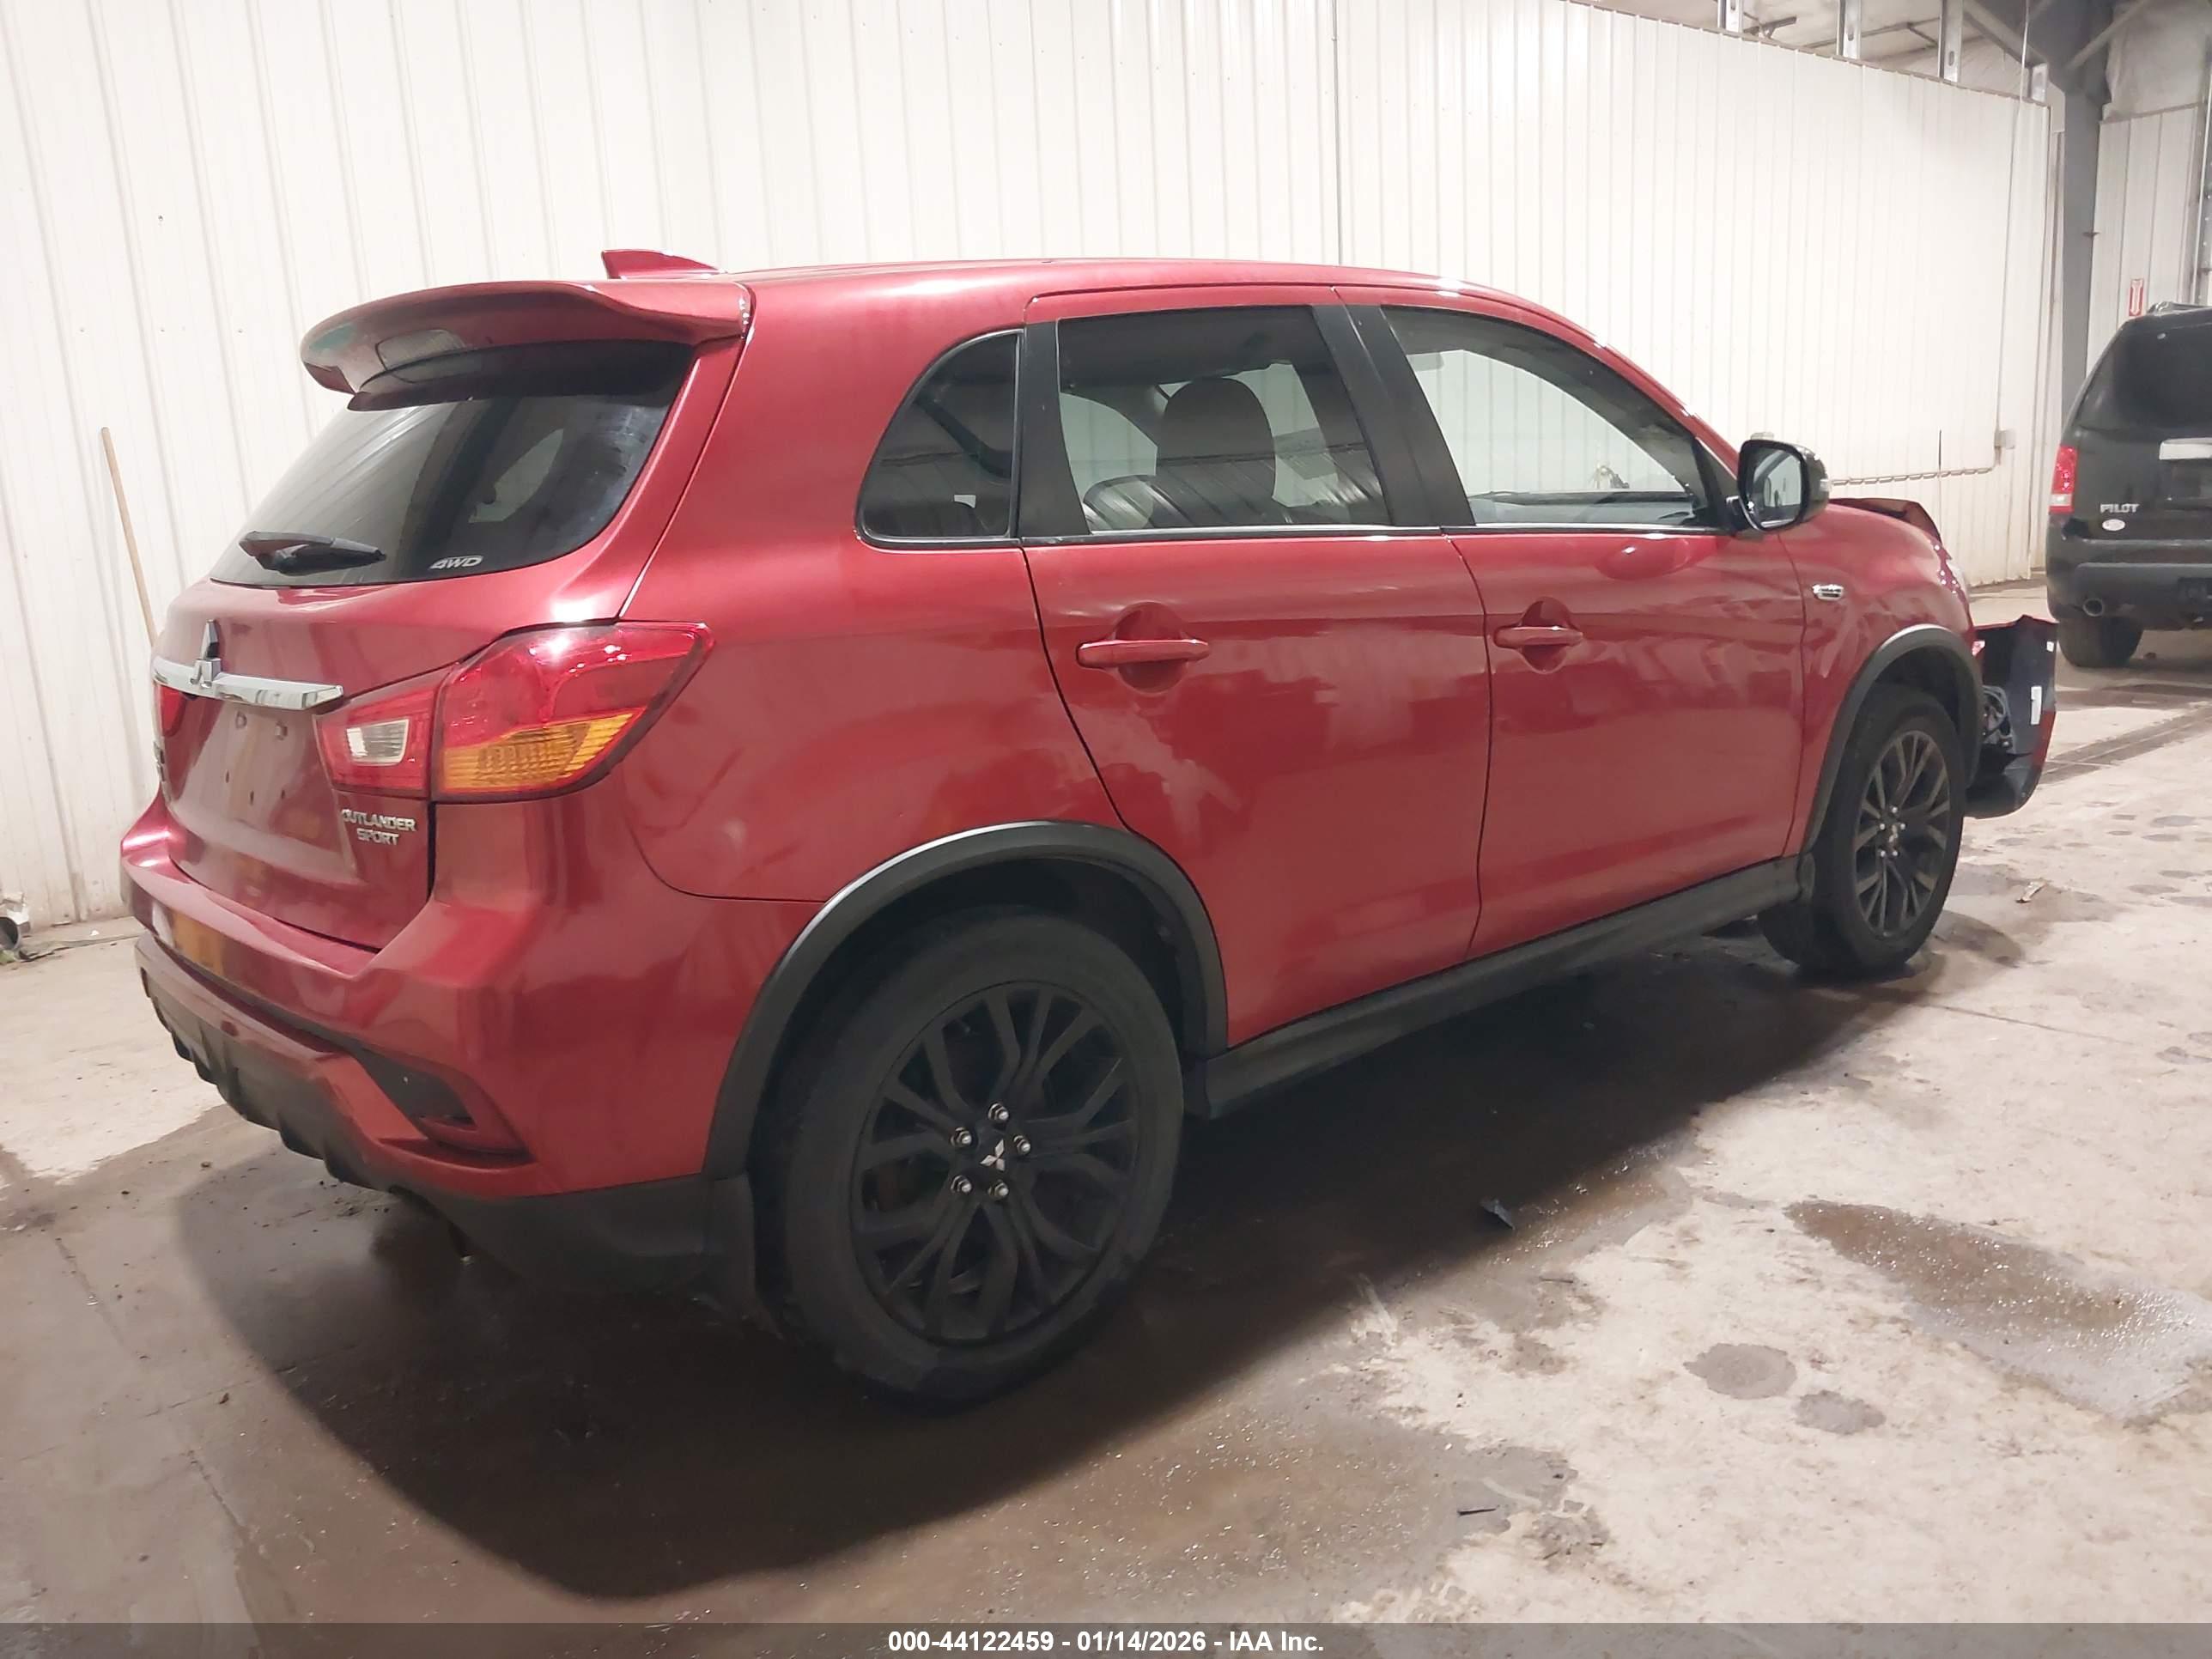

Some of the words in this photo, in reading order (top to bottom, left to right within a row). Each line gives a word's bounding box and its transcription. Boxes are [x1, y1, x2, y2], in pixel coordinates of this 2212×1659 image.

[2100, 503, 2140, 514] PILOT
[429, 556, 483, 569] 4WD
[342, 809, 416, 832] OUTLANDER
[356, 828, 399, 846] SPORT
